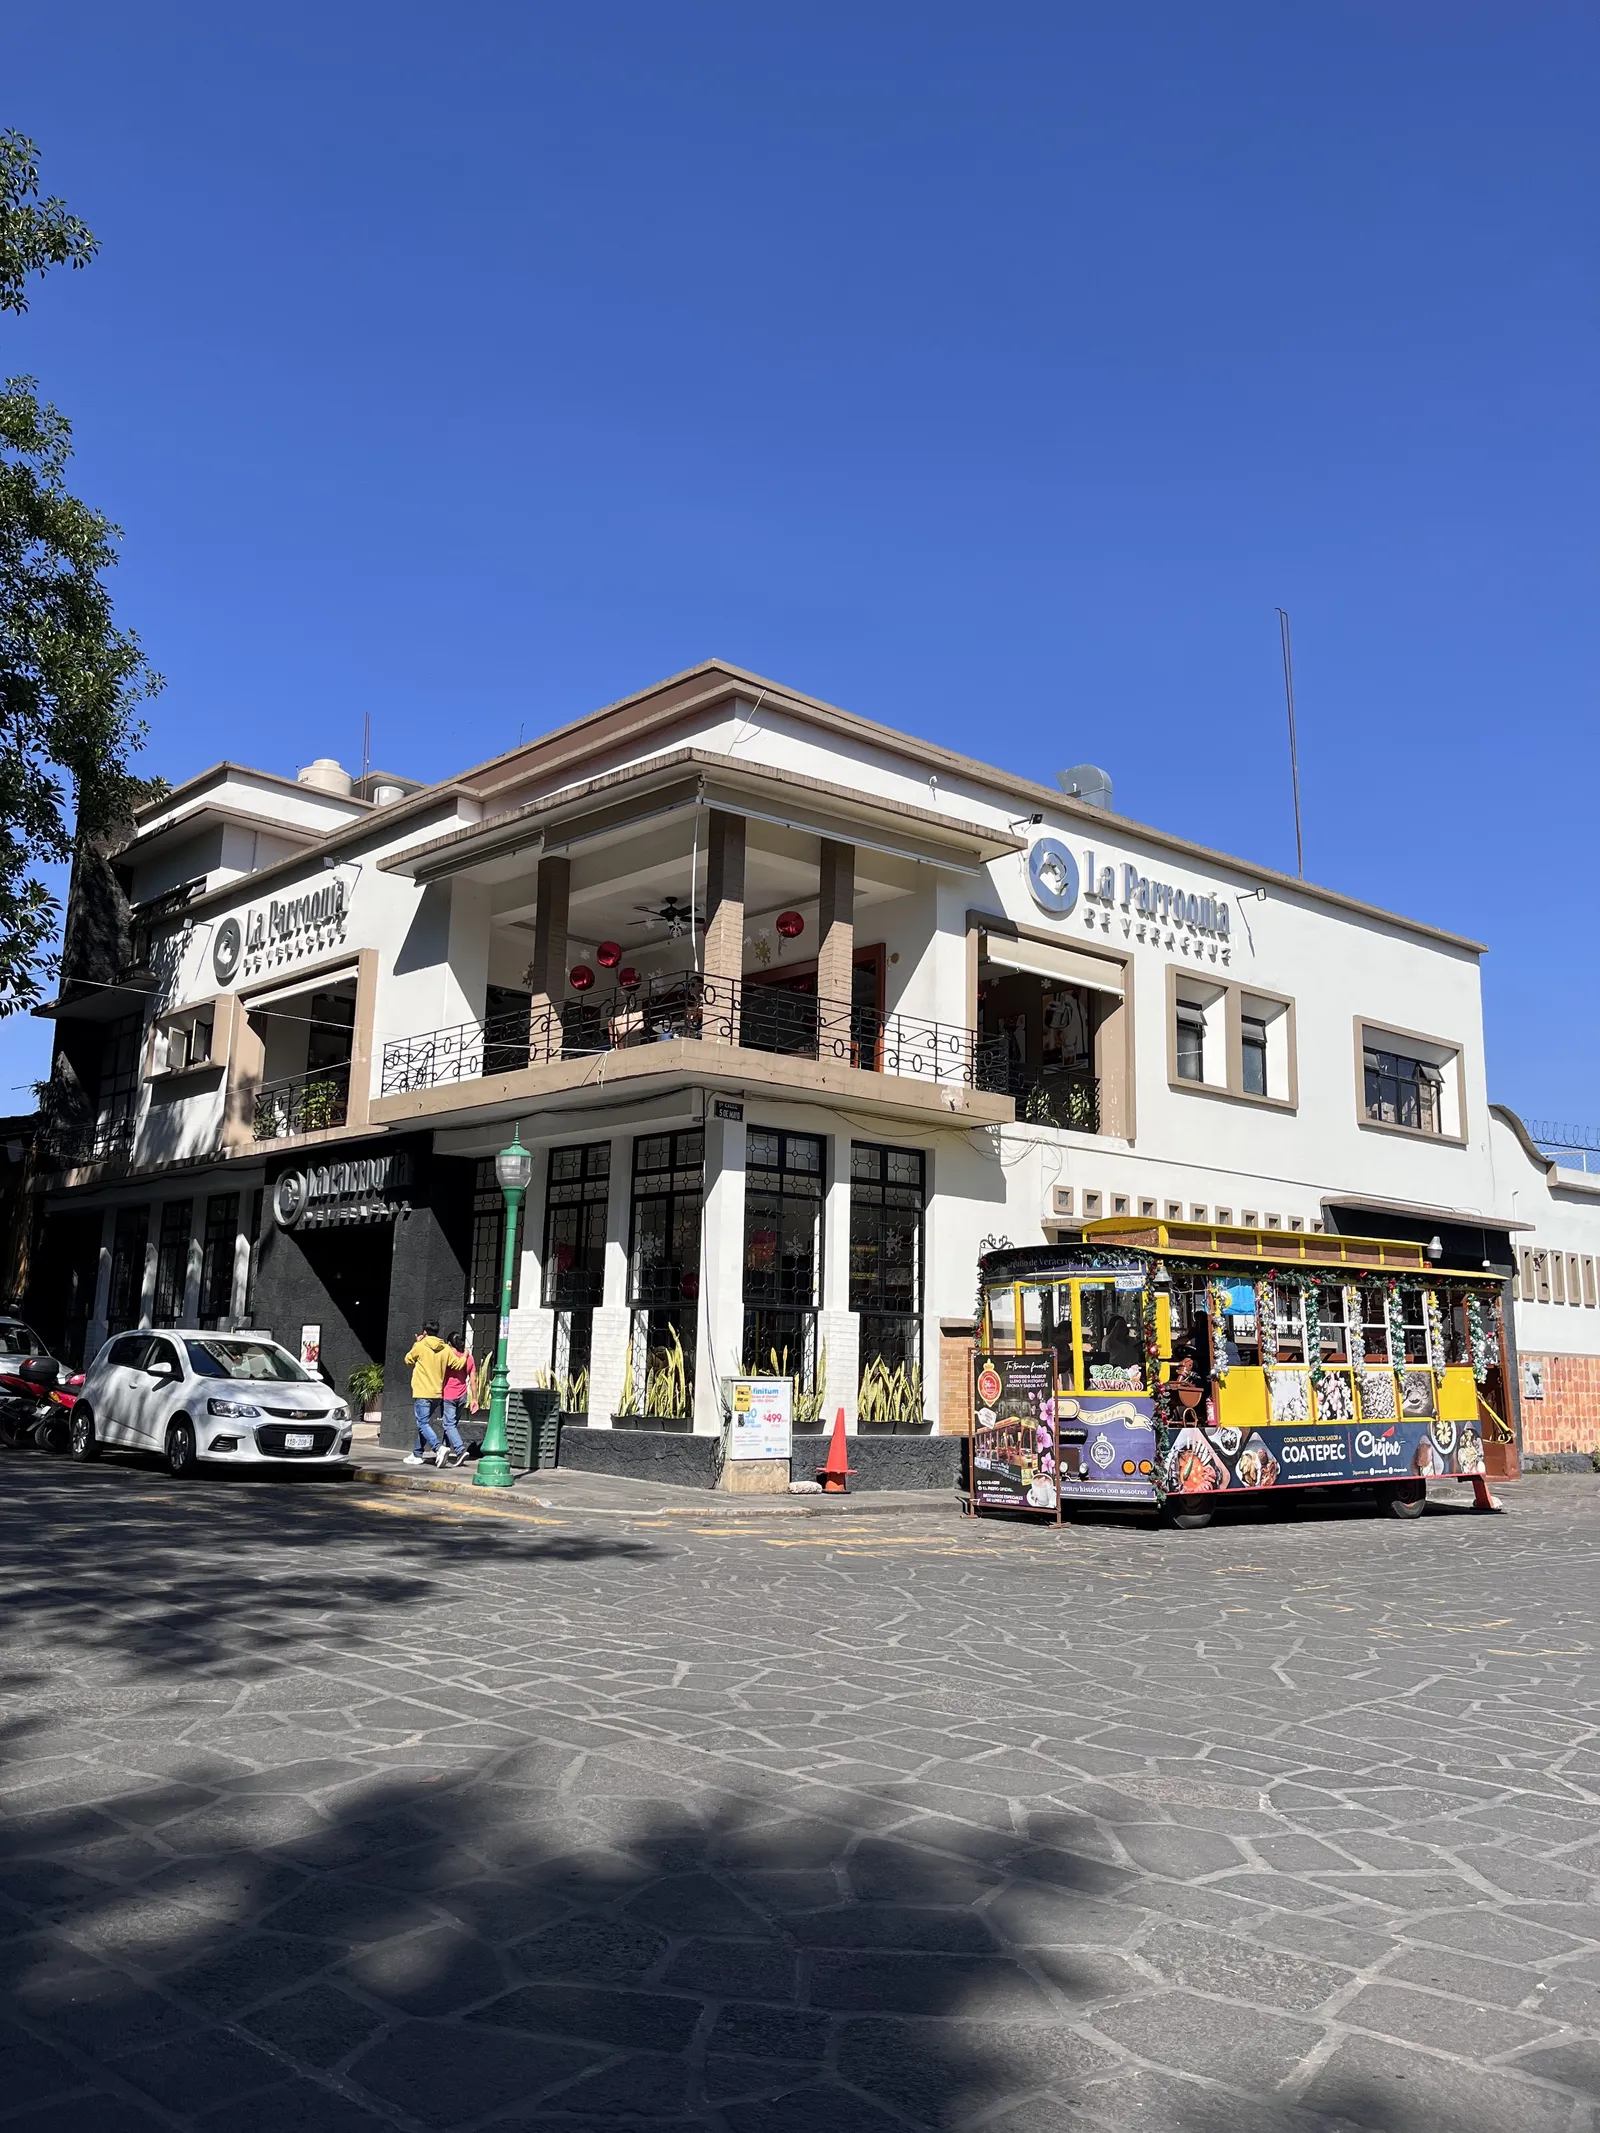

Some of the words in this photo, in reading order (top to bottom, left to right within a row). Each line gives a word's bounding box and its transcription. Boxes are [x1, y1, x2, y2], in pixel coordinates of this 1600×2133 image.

[1082, 850, 1115, 901] La
[1119, 862, 1230, 935] Parroquia
[245, 909, 267, 948] La
[269, 876, 349, 939] Parroquia
[243, 955, 263, 970] DE
[266, 923, 348, 961] VERACRUZ
[1083, 908, 1111, 925] DE
[1120, 918, 1231, 960] VERACRUZ
[719, 1108, 723, 1117] 5
[723, 1109, 729, 1118] DE
[729, 1111, 740, 1119] MAYO
[307, 1166, 330, 1197] La
[1029, 1258, 1038, 1267] de
[751, 1387, 779, 1395] finitum
[1281, 1443, 1347, 1463] COATEPEC
